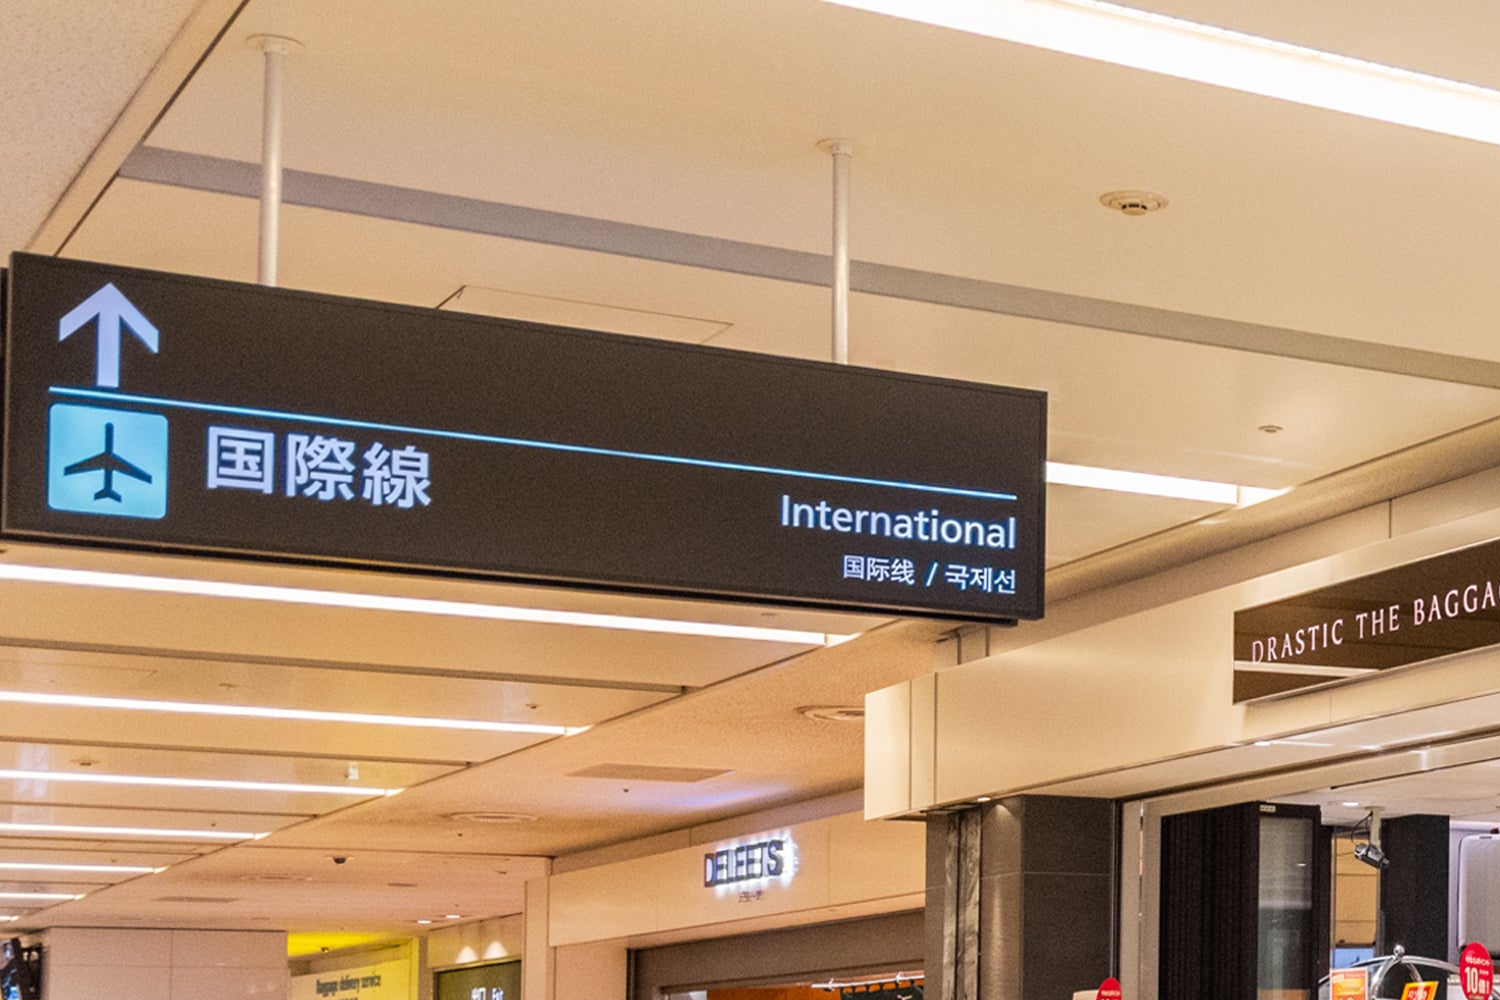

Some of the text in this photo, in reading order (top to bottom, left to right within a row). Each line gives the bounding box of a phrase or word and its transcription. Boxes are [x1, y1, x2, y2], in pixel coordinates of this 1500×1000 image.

[205, 425, 433, 508] 国際線
[781, 494, 1017, 550] International
[842, 555, 915, 586] 国际线
[944, 564, 1017, 595] 국제선
[1251, 619, 1344, 665] DRASTIC
[1356, 604, 1400, 640] THE
